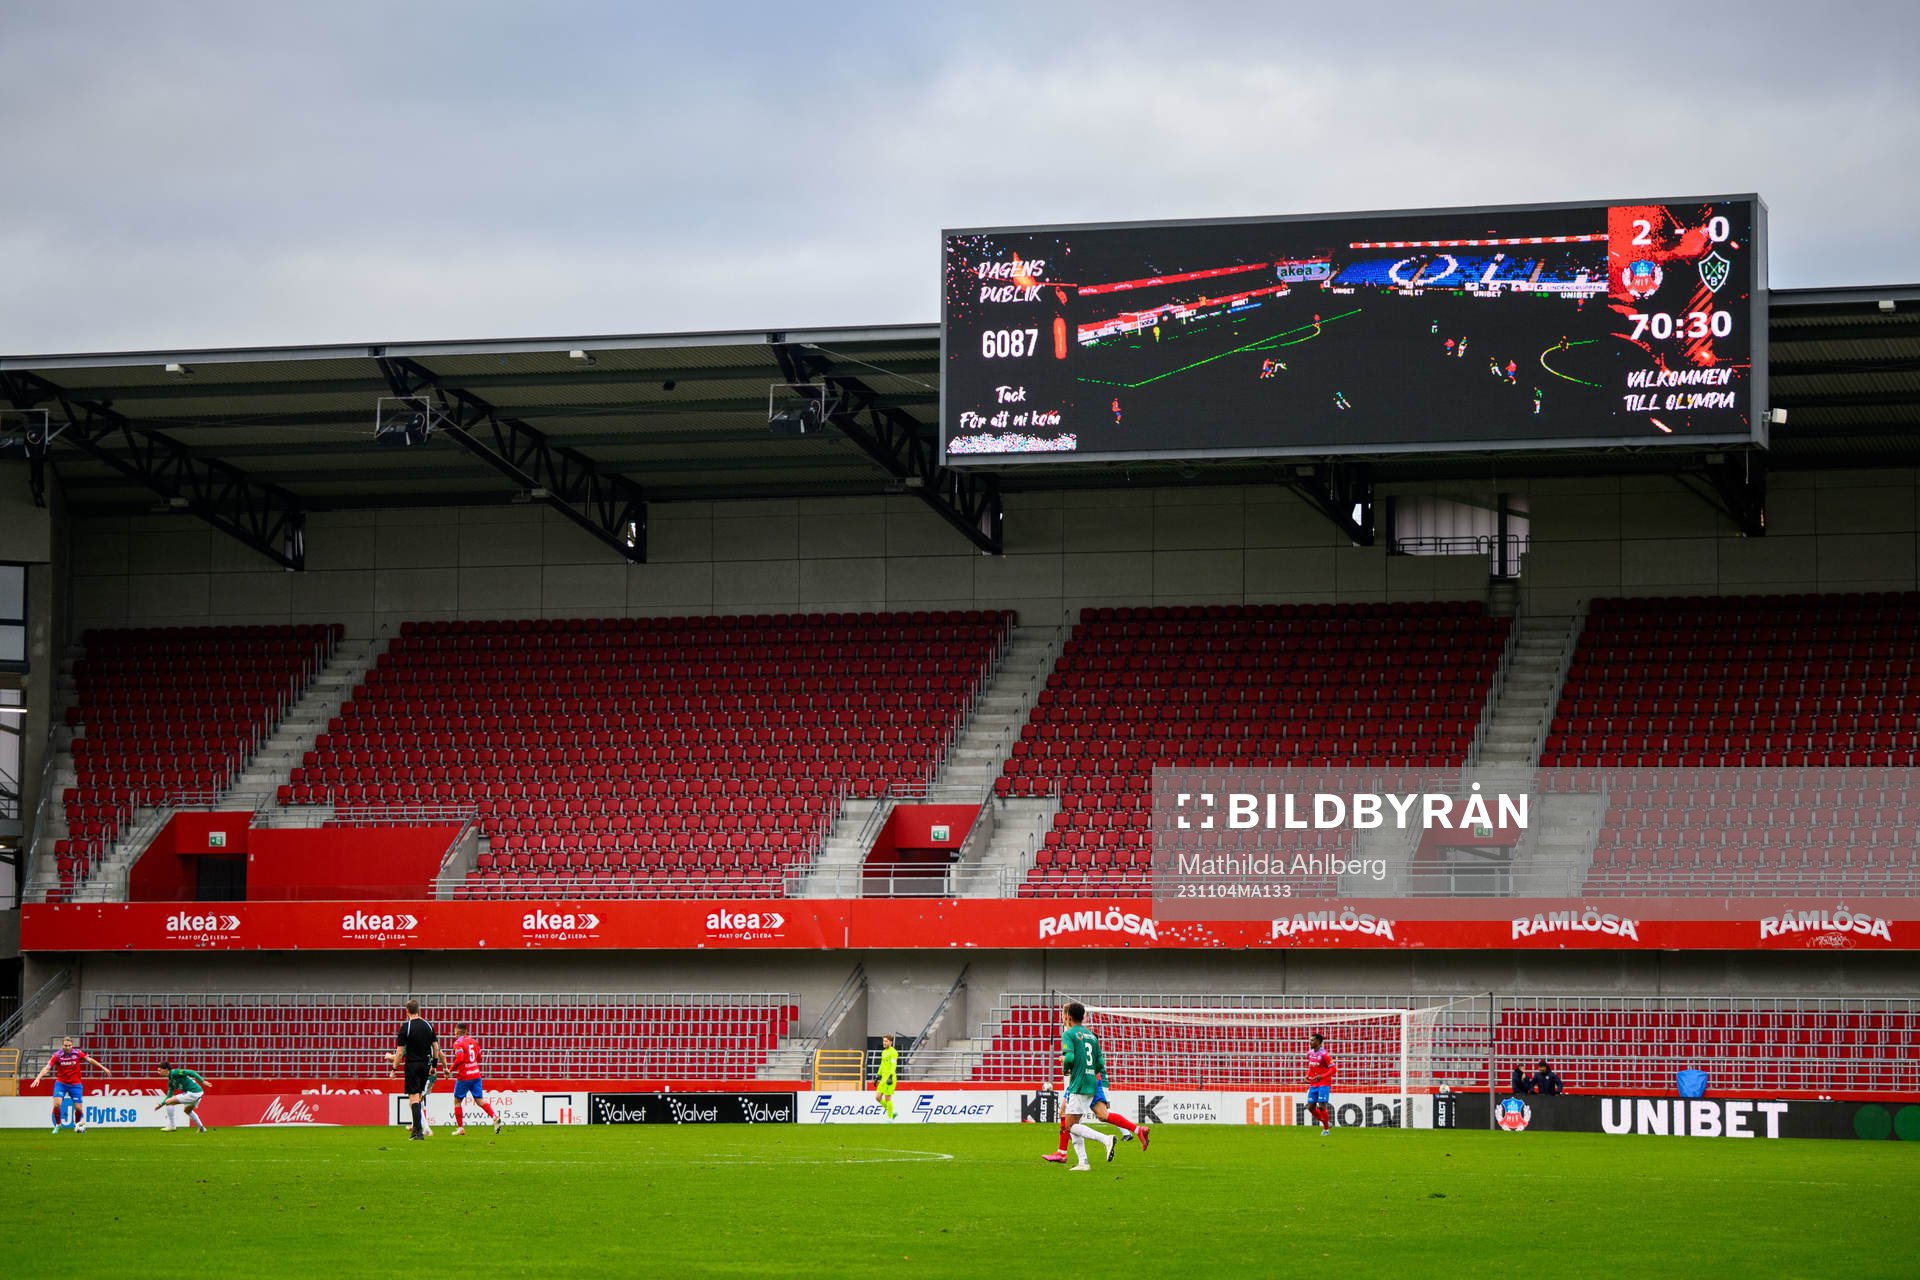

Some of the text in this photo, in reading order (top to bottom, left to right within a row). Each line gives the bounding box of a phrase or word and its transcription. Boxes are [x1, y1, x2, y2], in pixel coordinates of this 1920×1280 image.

[1631, 219, 1652, 246] 2
[1709, 216, 1730, 242] 0
[978, 259, 1046, 279] DAGENS
[1280, 264, 1312, 277] akea
[979, 284, 1043, 303] PUBLIK
[1628, 311, 1732, 340] 70:30
[982, 329, 1038, 358] 6087
[995, 386, 1026, 403] Tack
[1623, 392, 1735, 411] TILL OLYMPIA
[990, 410, 1010, 428] att
[1013, 411, 1029, 427] ni
[1031, 410, 1061, 426] kom
[166, 911, 217, 931] akea
[342, 910, 394, 931] akea
[522, 909, 575, 930] akea
[706, 908, 760, 930] akea
[1039, 906, 1158, 941] RAMLÖSA
[1271, 906, 1395, 941] RAMLÖSA
[1511, 905, 1639, 942] RAMLÖSA
[1760, 905, 1892, 942] RAMLÖSA
[468, 1044, 475, 1063] 5
[1084, 1042, 1093, 1066] 3
[86, 1106, 137, 1124] Flytt.se
[260, 1095, 315, 1123] Melitta
[448, 1110, 529, 1119] www.15.se
[605, 1103, 647, 1122] Valvet
[677, 1103, 718, 1122] Valvet
[748, 1103, 790, 1122] Valvet
[934, 1105, 994, 1115] BOLAGET
[1039, 1097, 1048, 1122] SELECT
[1173, 1103, 1212, 1111] KAPITAL
[1173, 1113, 1217, 1121] GRUPPEN
[1438, 1101, 1446, 1127] SELECT
[1601, 1098, 1789, 1139] UNIBET
